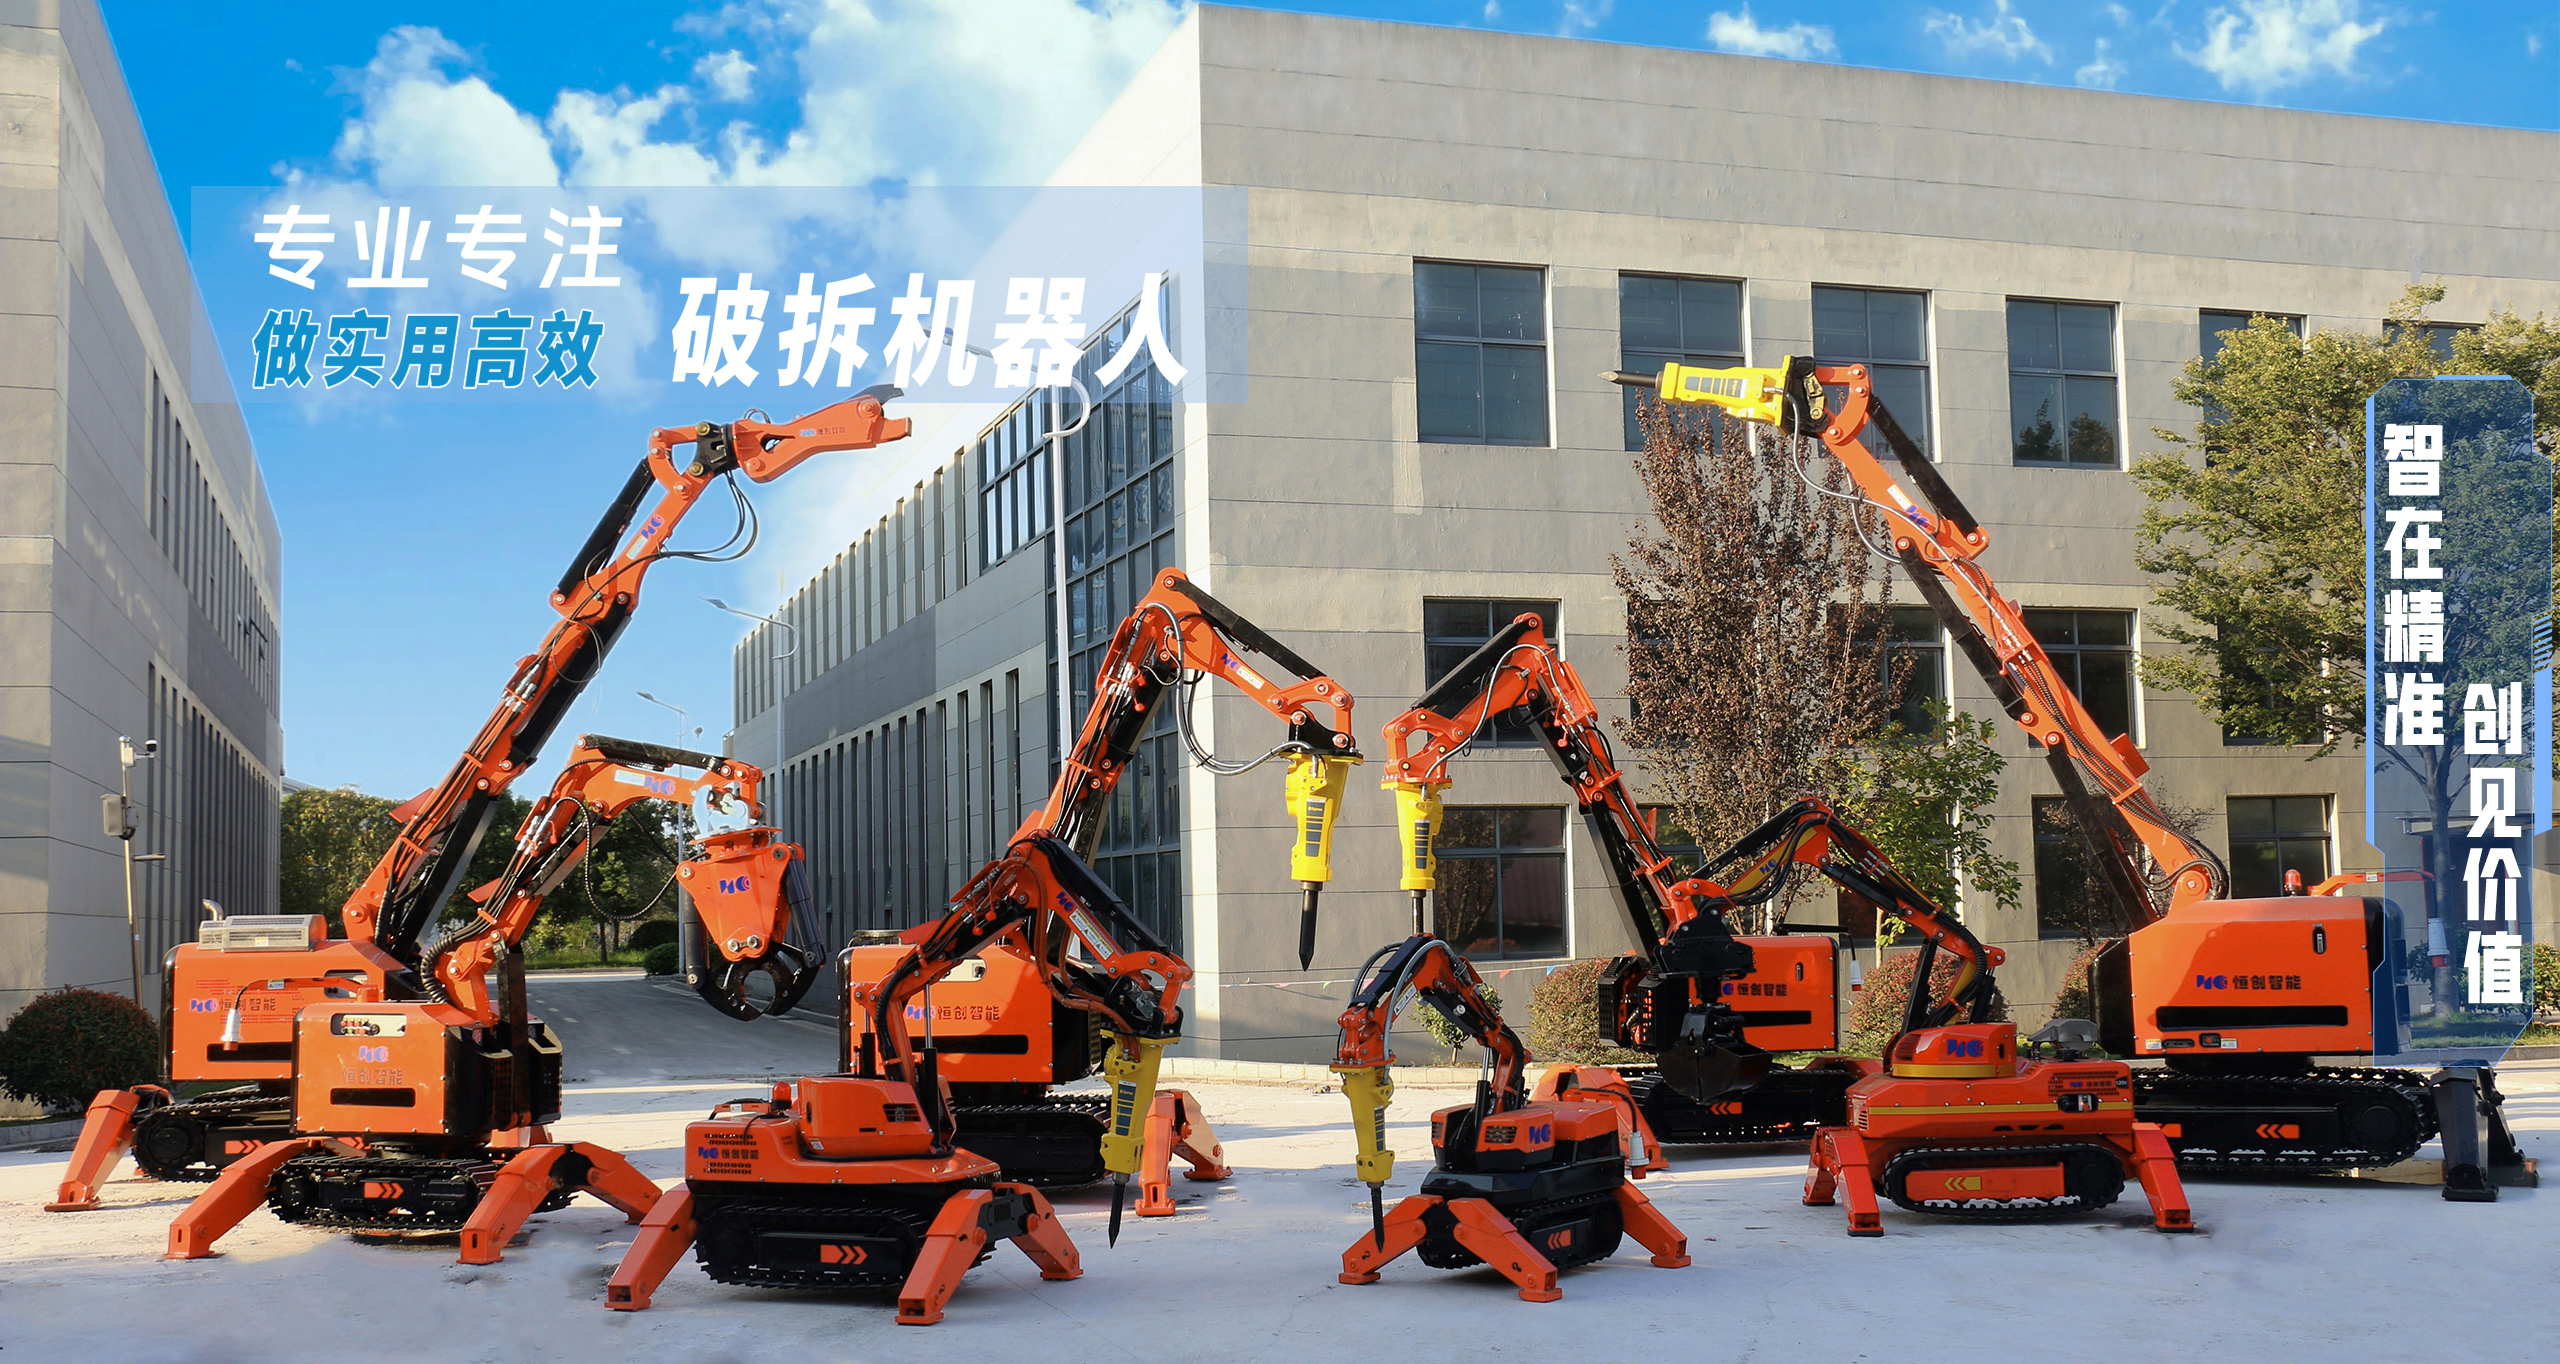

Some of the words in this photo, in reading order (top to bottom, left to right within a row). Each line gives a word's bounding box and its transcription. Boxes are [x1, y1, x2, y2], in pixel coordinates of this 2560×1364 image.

[1737, 983, 1787, 996] 恒创智能
[2233, 975, 2302, 990] 恒创智能
[938, 1005, 1000, 1020] 恒创智能
[343, 1068, 403, 1085] 恒创智能
